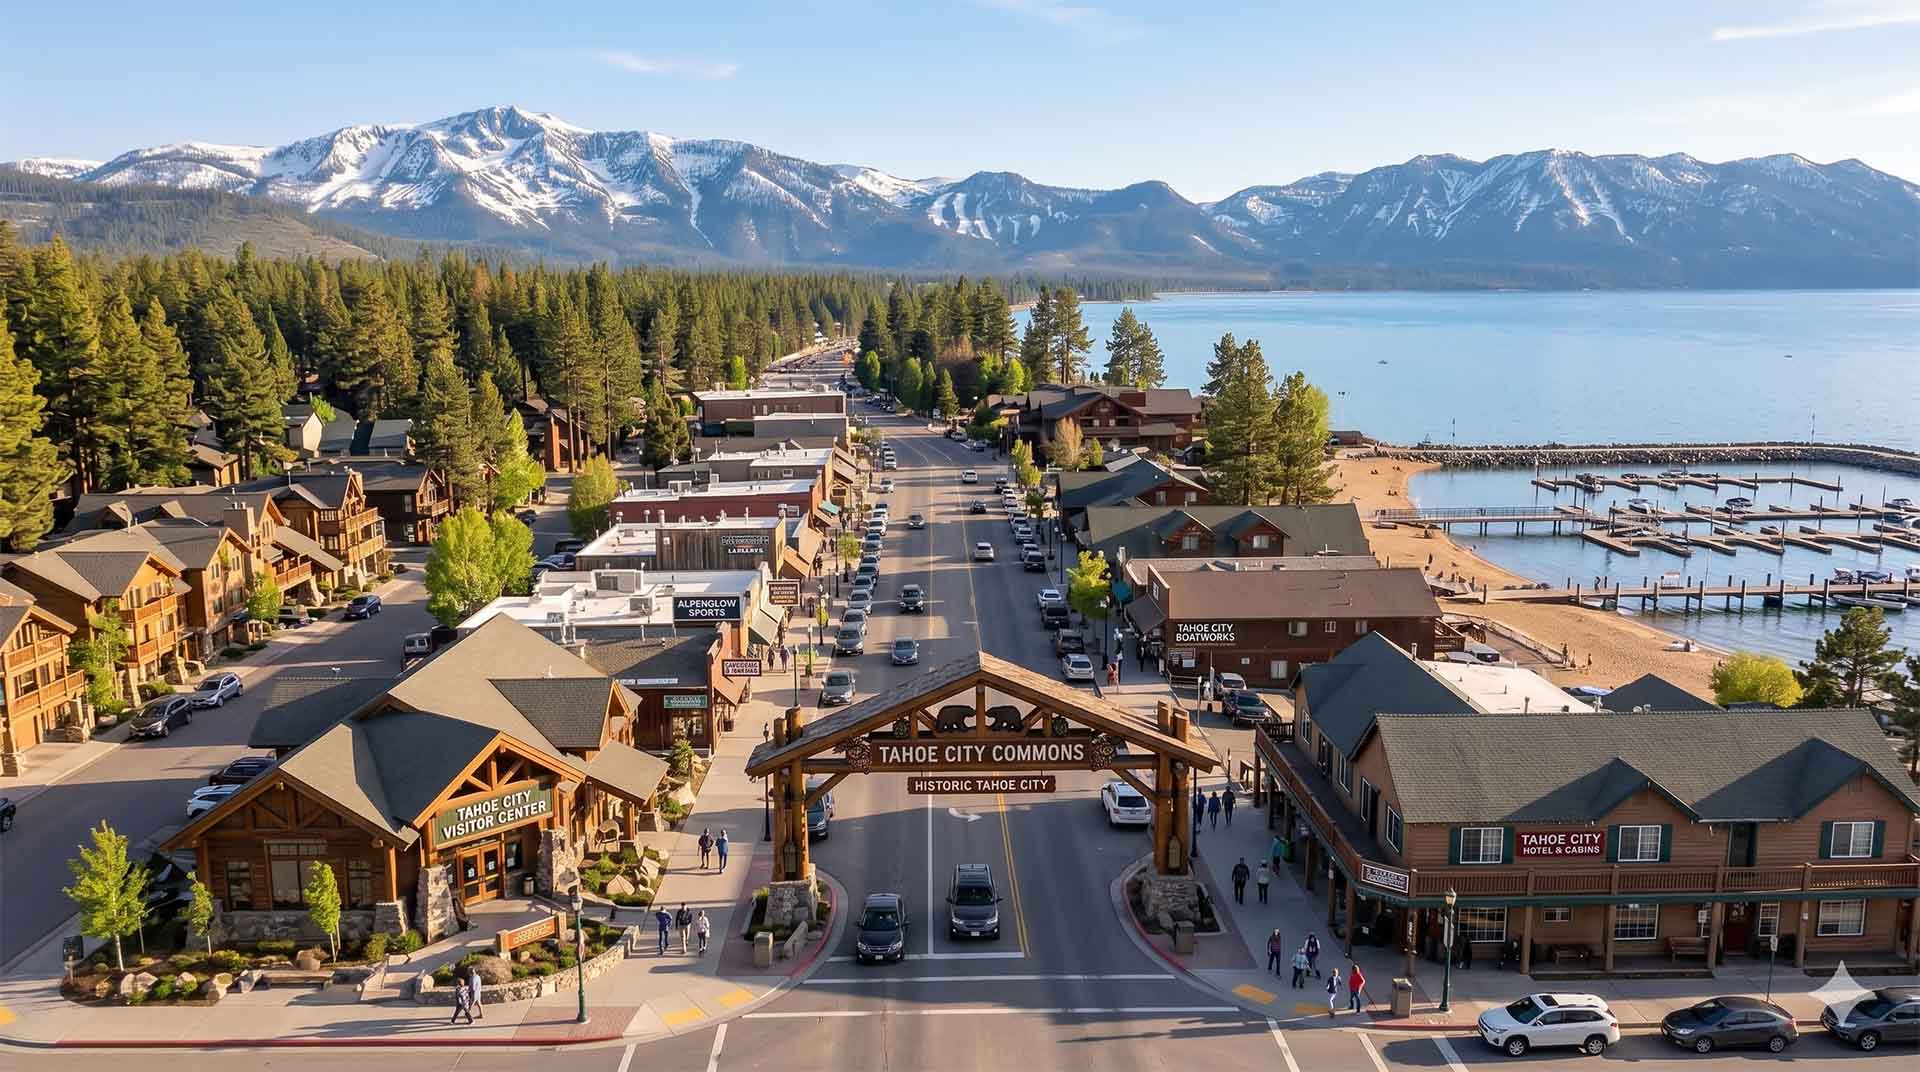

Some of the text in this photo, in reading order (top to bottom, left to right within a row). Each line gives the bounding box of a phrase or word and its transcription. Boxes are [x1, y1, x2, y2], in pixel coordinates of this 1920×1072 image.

[678, 600, 736, 608] ALPENGLOW
[1178, 624, 1234, 632] TAHOE CITY
[1176, 632, 1235, 642] BOATWORKS
[879, 744, 1084, 763] TAHOE CITY COMMONS
[915, 780, 1048, 792] HISTORIC TAHOE CITY
[457, 790, 531, 820] TAHOE CITY
[443, 800, 546, 839] VISITOR CENTER
[1521, 834, 1600, 844] TAHOE CITY
[1564, 846, 1600, 854] CABINS
